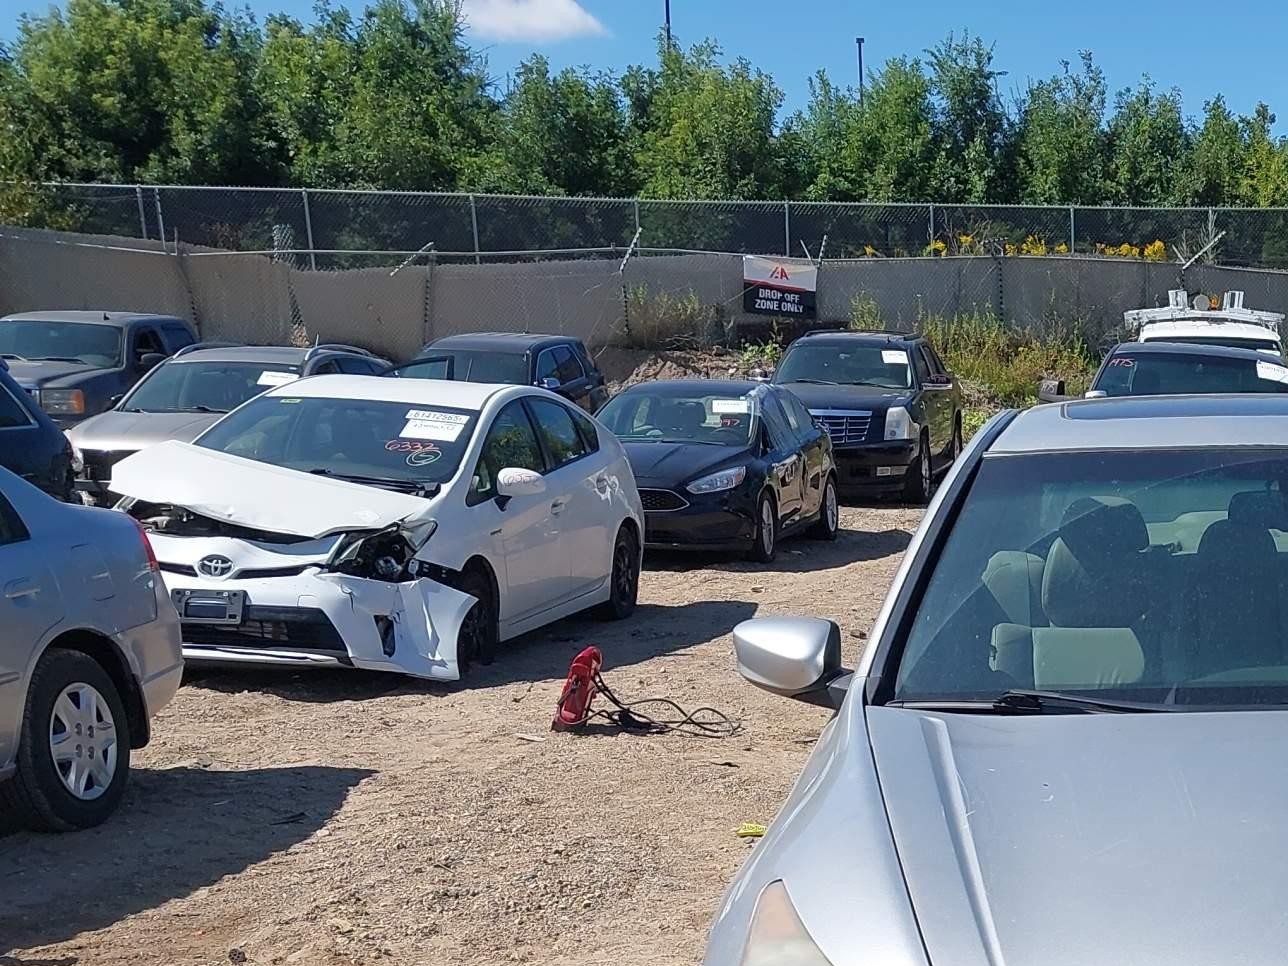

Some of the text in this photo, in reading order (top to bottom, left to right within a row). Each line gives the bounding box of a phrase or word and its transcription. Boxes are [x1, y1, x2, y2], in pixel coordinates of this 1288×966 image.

[784, 293, 800, 303] OFF
[755, 299, 804, 313] ZONE ONLY
